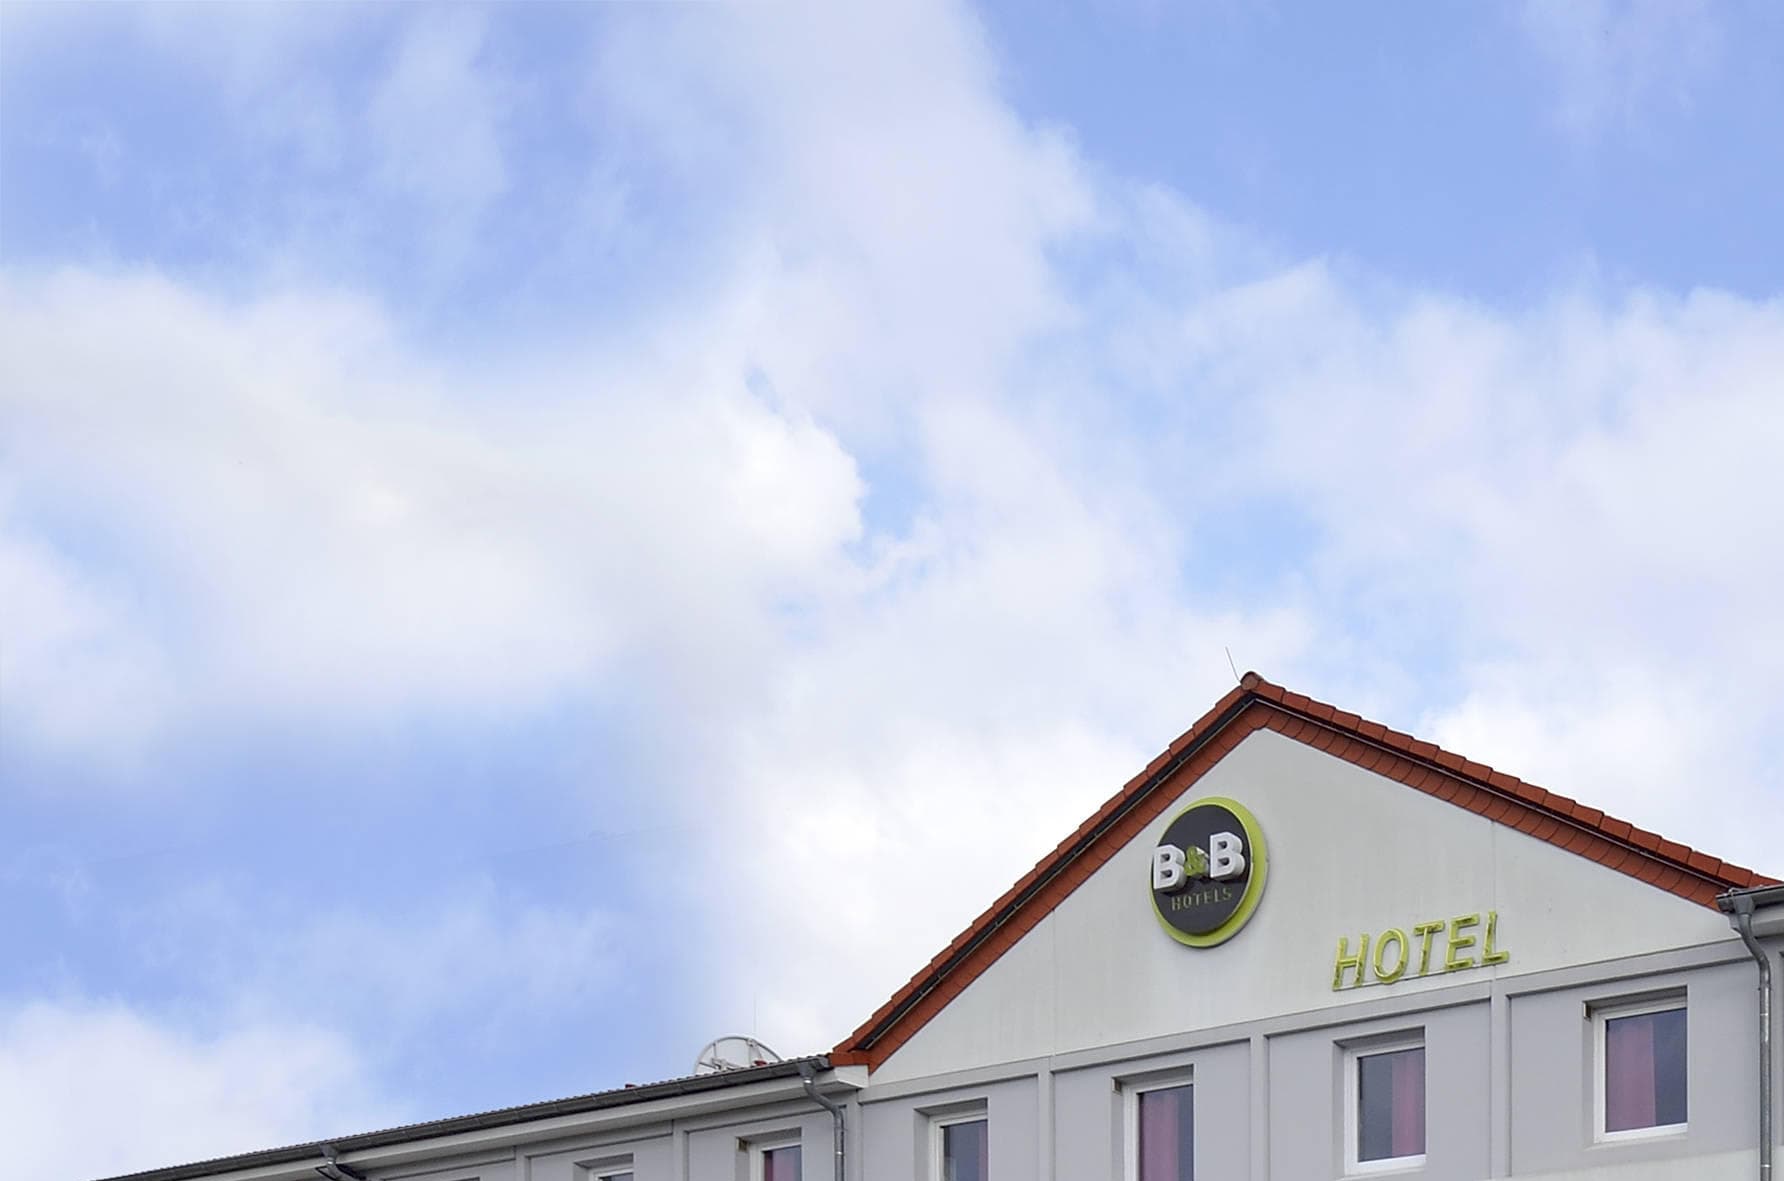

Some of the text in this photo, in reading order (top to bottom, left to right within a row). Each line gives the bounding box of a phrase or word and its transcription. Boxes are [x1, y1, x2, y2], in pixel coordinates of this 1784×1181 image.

[1153, 831, 1245, 890] B&B
[1171, 887, 1233, 911] HOTELS
[1332, 910, 1510, 992] HOTEL
